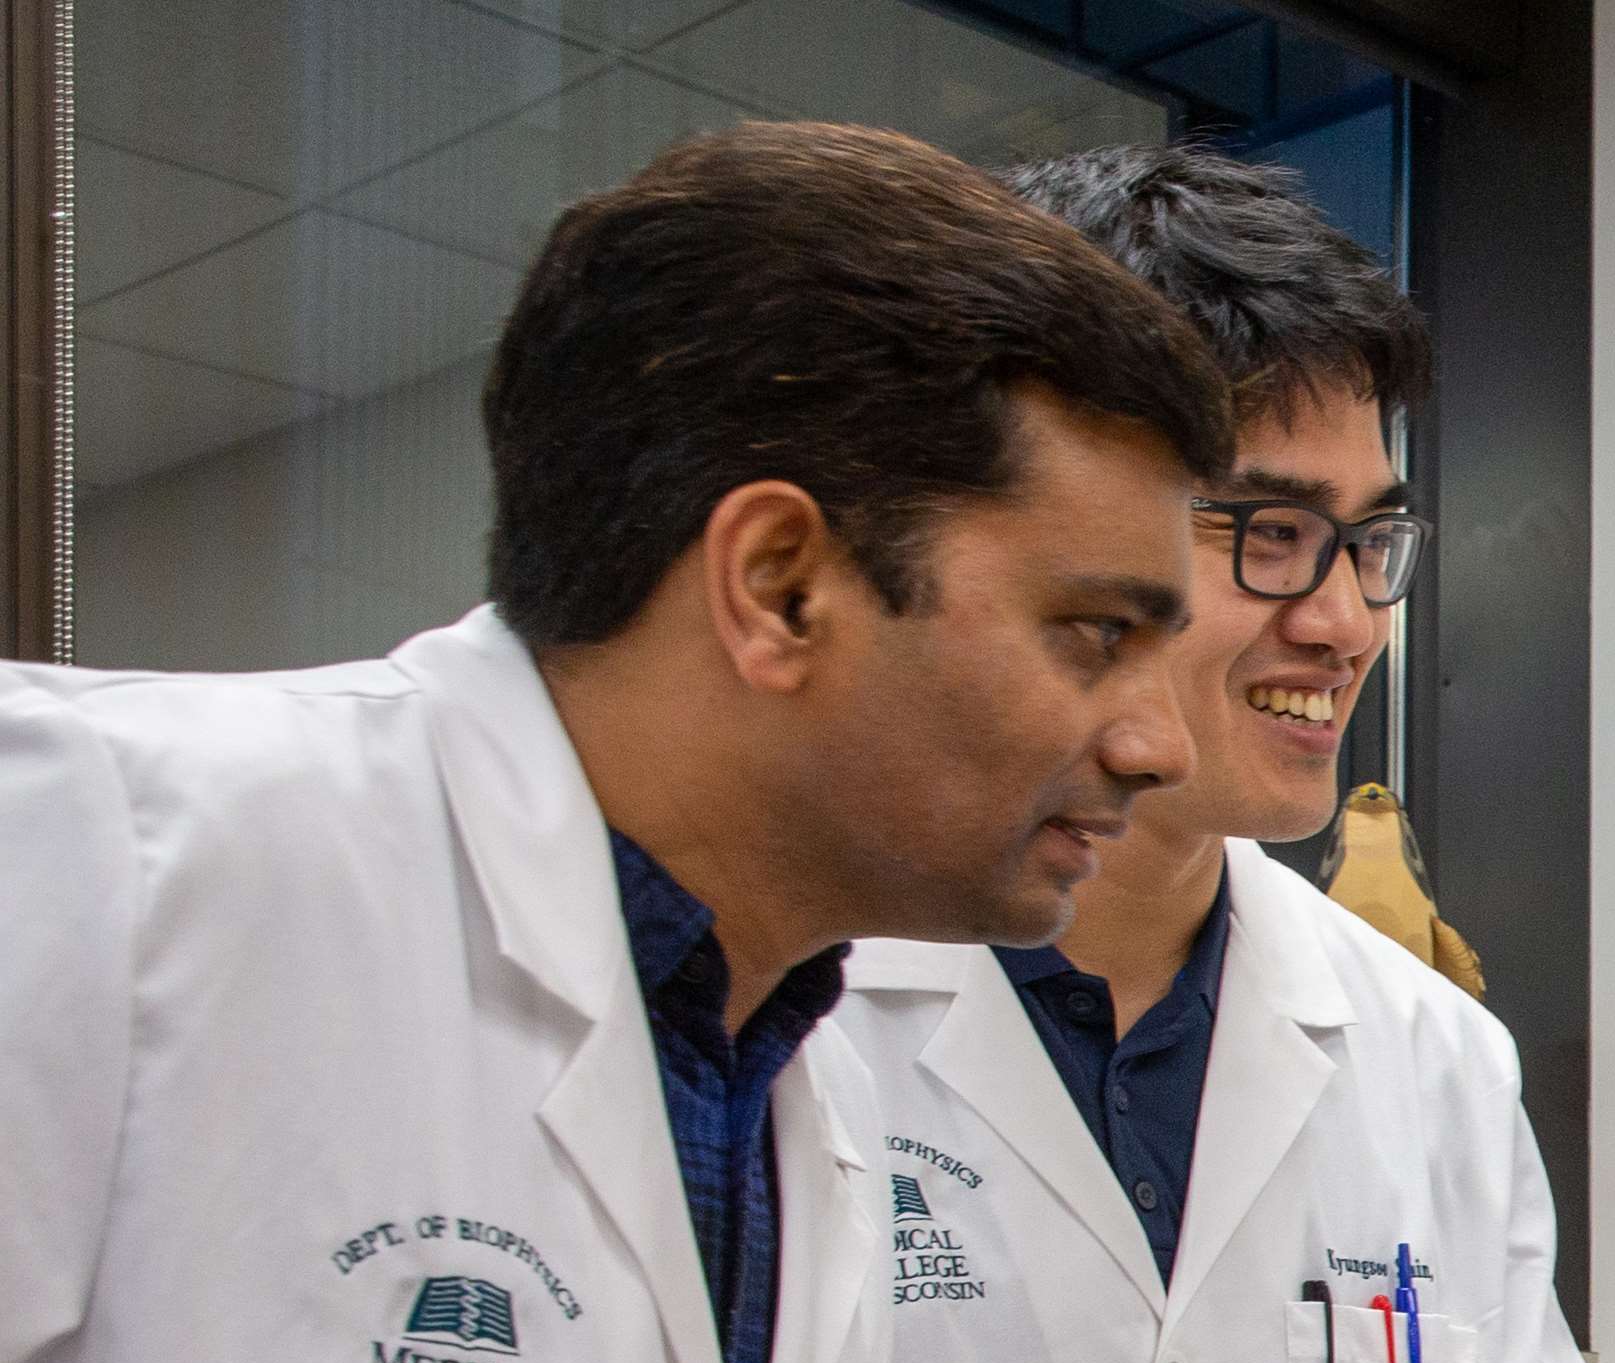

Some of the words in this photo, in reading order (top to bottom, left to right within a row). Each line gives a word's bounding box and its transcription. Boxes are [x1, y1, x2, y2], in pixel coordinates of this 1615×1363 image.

[884, 1135, 984, 1190] OPHYSICS
[331, 1222, 404, 1275] DEPT.
[416, 1215, 447, 1239] OF
[456, 1218, 583, 1321] BIOPHYSICS
[894, 1254, 970, 1281] LEGE
